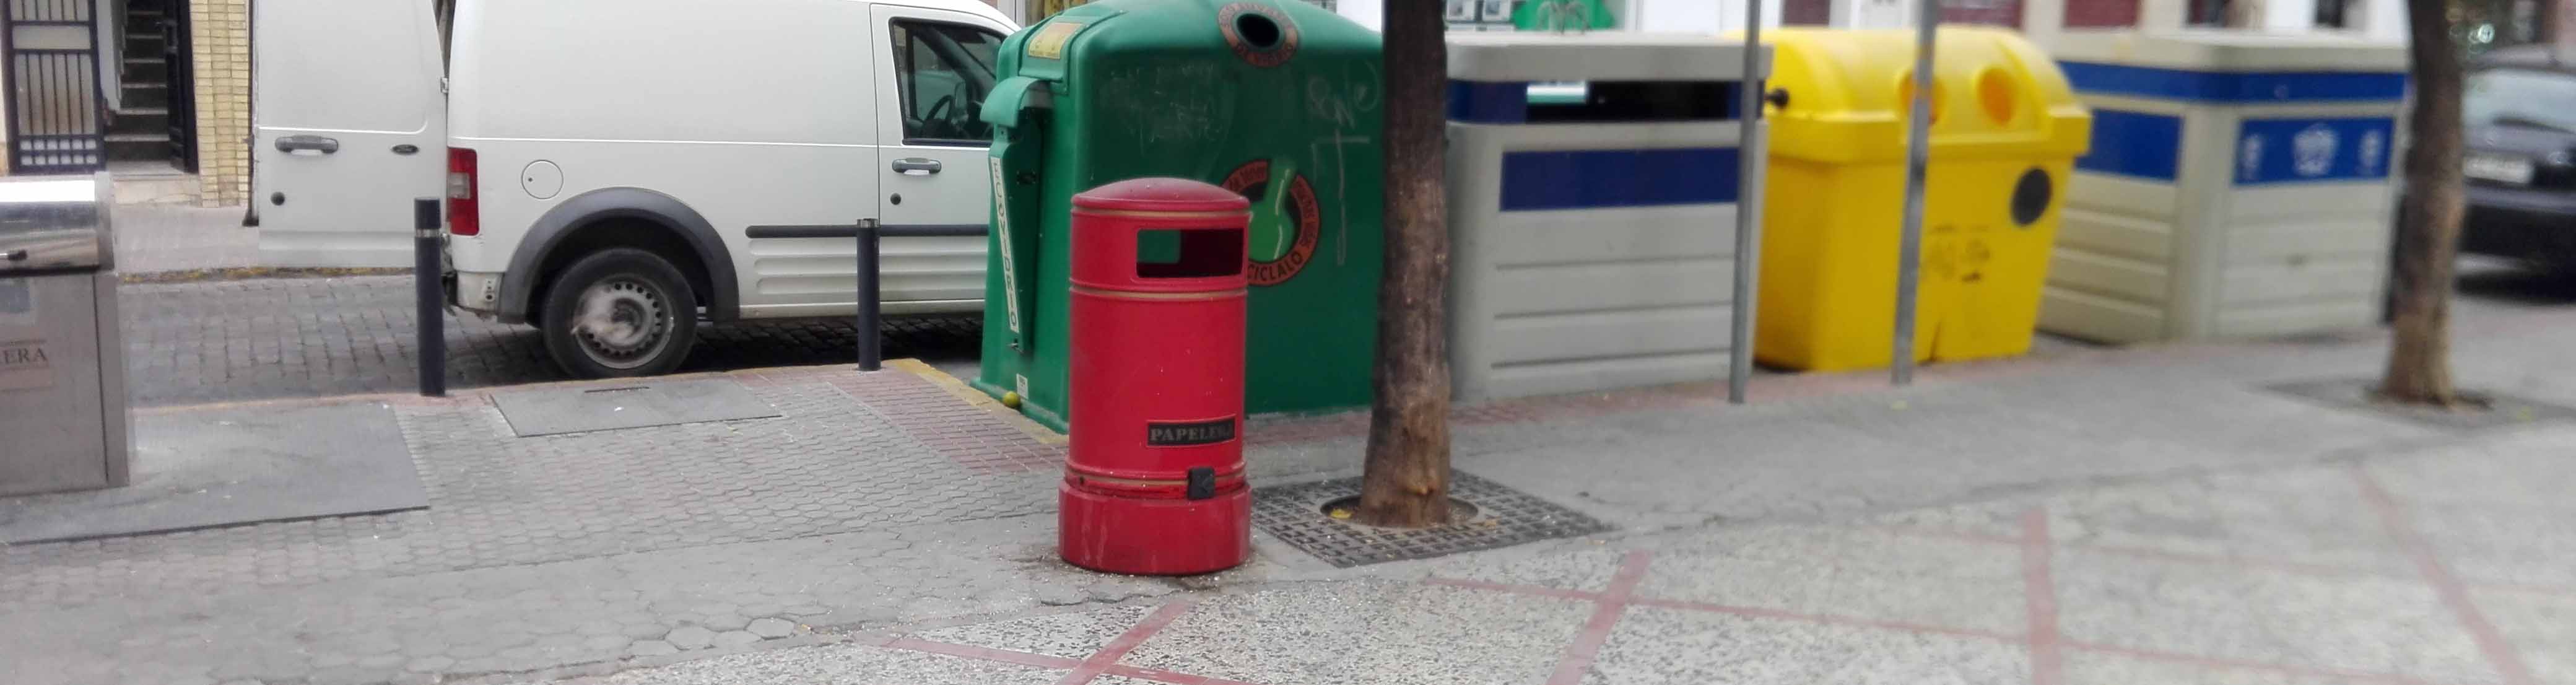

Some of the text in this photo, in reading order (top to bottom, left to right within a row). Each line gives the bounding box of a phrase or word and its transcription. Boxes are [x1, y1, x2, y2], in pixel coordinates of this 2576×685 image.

[993, 162, 1017, 326] ECOVIDRIO
[1247, 251, 1303, 282] CICLALO
[0, 347, 48, 364] ERA
